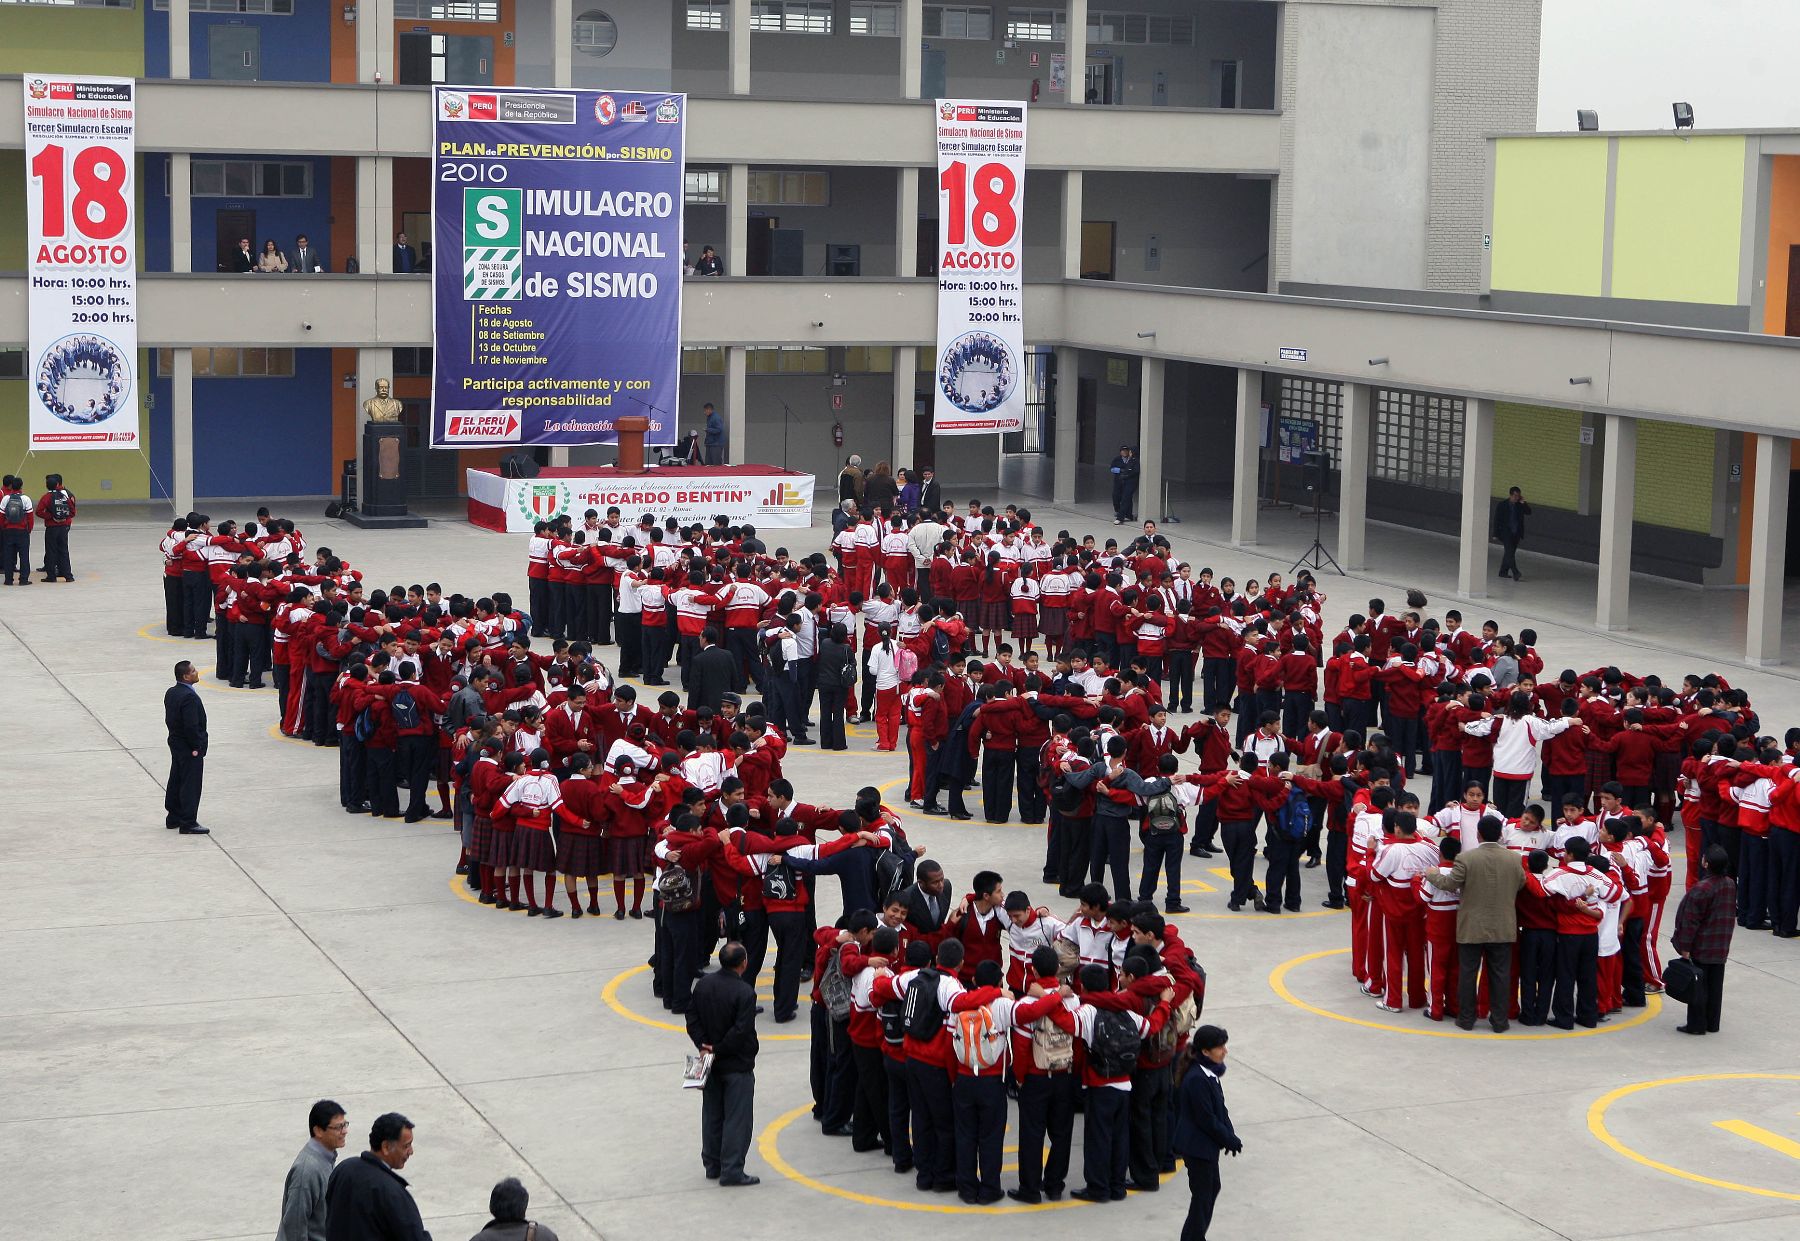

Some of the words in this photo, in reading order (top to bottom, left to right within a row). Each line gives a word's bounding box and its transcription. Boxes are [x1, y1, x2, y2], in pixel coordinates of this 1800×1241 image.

[51, 84, 72, 92] PERÚ
[472, 102, 492, 110] PERÚ
[28, 106, 64, 117] Simulacro
[68, 106, 98, 118] Nacional
[100, 107, 109, 118] de
[110, 108, 132, 119] Sismo
[28, 122, 55, 132] Tercer
[57, 124, 100, 133] Simulacro
[102, 125, 132, 134] Escolar
[939, 127, 967, 137] Simulacro
[970, 128, 995, 137] Nacional
[997, 128, 1004, 138] de
[1005, 128, 1022, 138] Sismo
[441, 142, 485, 155] PLAN
[486, 148, 496, 156] de
[497, 143, 606, 158] PREVENCIÓN
[606, 151, 620, 160] por
[620, 147, 672, 160] SISMO
[939, 142, 960, 150] Tercer
[962, 142, 995, 151] Simulacro
[998, 144, 1022, 152] Escolar
[441, 163, 508, 182] 2010
[32, 143, 128, 240] 18
[941, 160, 1016, 247] 18
[526, 231, 666, 258] NACIONAL
[36, 244, 127, 264] AGOSTO
[942, 252, 1015, 269] AGOSTO
[33, 277, 68, 288] Hora:
[72, 278, 105, 288] 10:00
[109, 277, 131, 289] hrs.
[525, 272, 559, 298] de
[566, 272, 658, 298] SISMO
[939, 280, 966, 290] Hora:
[969, 281, 997, 290] 10:00
[1000, 281, 1018, 291] hrs.
[72, 295, 104, 306] 15:00
[108, 294, 130, 306] hrs.
[969, 297, 995, 306] 15:00
[999, 296, 1016, 306] hrs.
[479, 305, 512, 314] Fechas
[72, 312, 108, 323] 20:00
[112, 312, 134, 323] hrs.
[969, 313, 999, 322] 20:00
[1003, 312, 1020, 322] hrs.
[479, 319, 488, 327] 18
[491, 319, 500, 327] de
[503, 318, 532, 329] Agosto
[479, 332, 488, 340] 08
[491, 331, 500, 340] de
[503, 331, 544, 340] Setiembre
[479, 344, 488, 352] 13
[491, 344, 500, 352] de
[503, 343, 536, 352] Octubre
[479, 356, 488, 364] 17
[491, 356, 500, 364] de
[503, 356, 547, 364] Noviembre
[464, 378, 524, 393] Participa
[528, 378, 610, 390] activamente
[614, 381, 622, 392] y
[626, 380, 651, 390] con
[502, 396, 612, 409] responsabilidad
[463, 417, 477, 425] EL
[478, 415, 506, 426] PERÚ
[544, 420, 560, 432] La
[460, 426, 503, 436] AVANZA
[591, 483, 638, 491] Institución
[640, 482, 683, 490] Educativa
[686, 480, 740, 490] Emblemática
[579, 491, 670, 504] “RICARDO
[676, 491, 752, 503] BENTIN”
